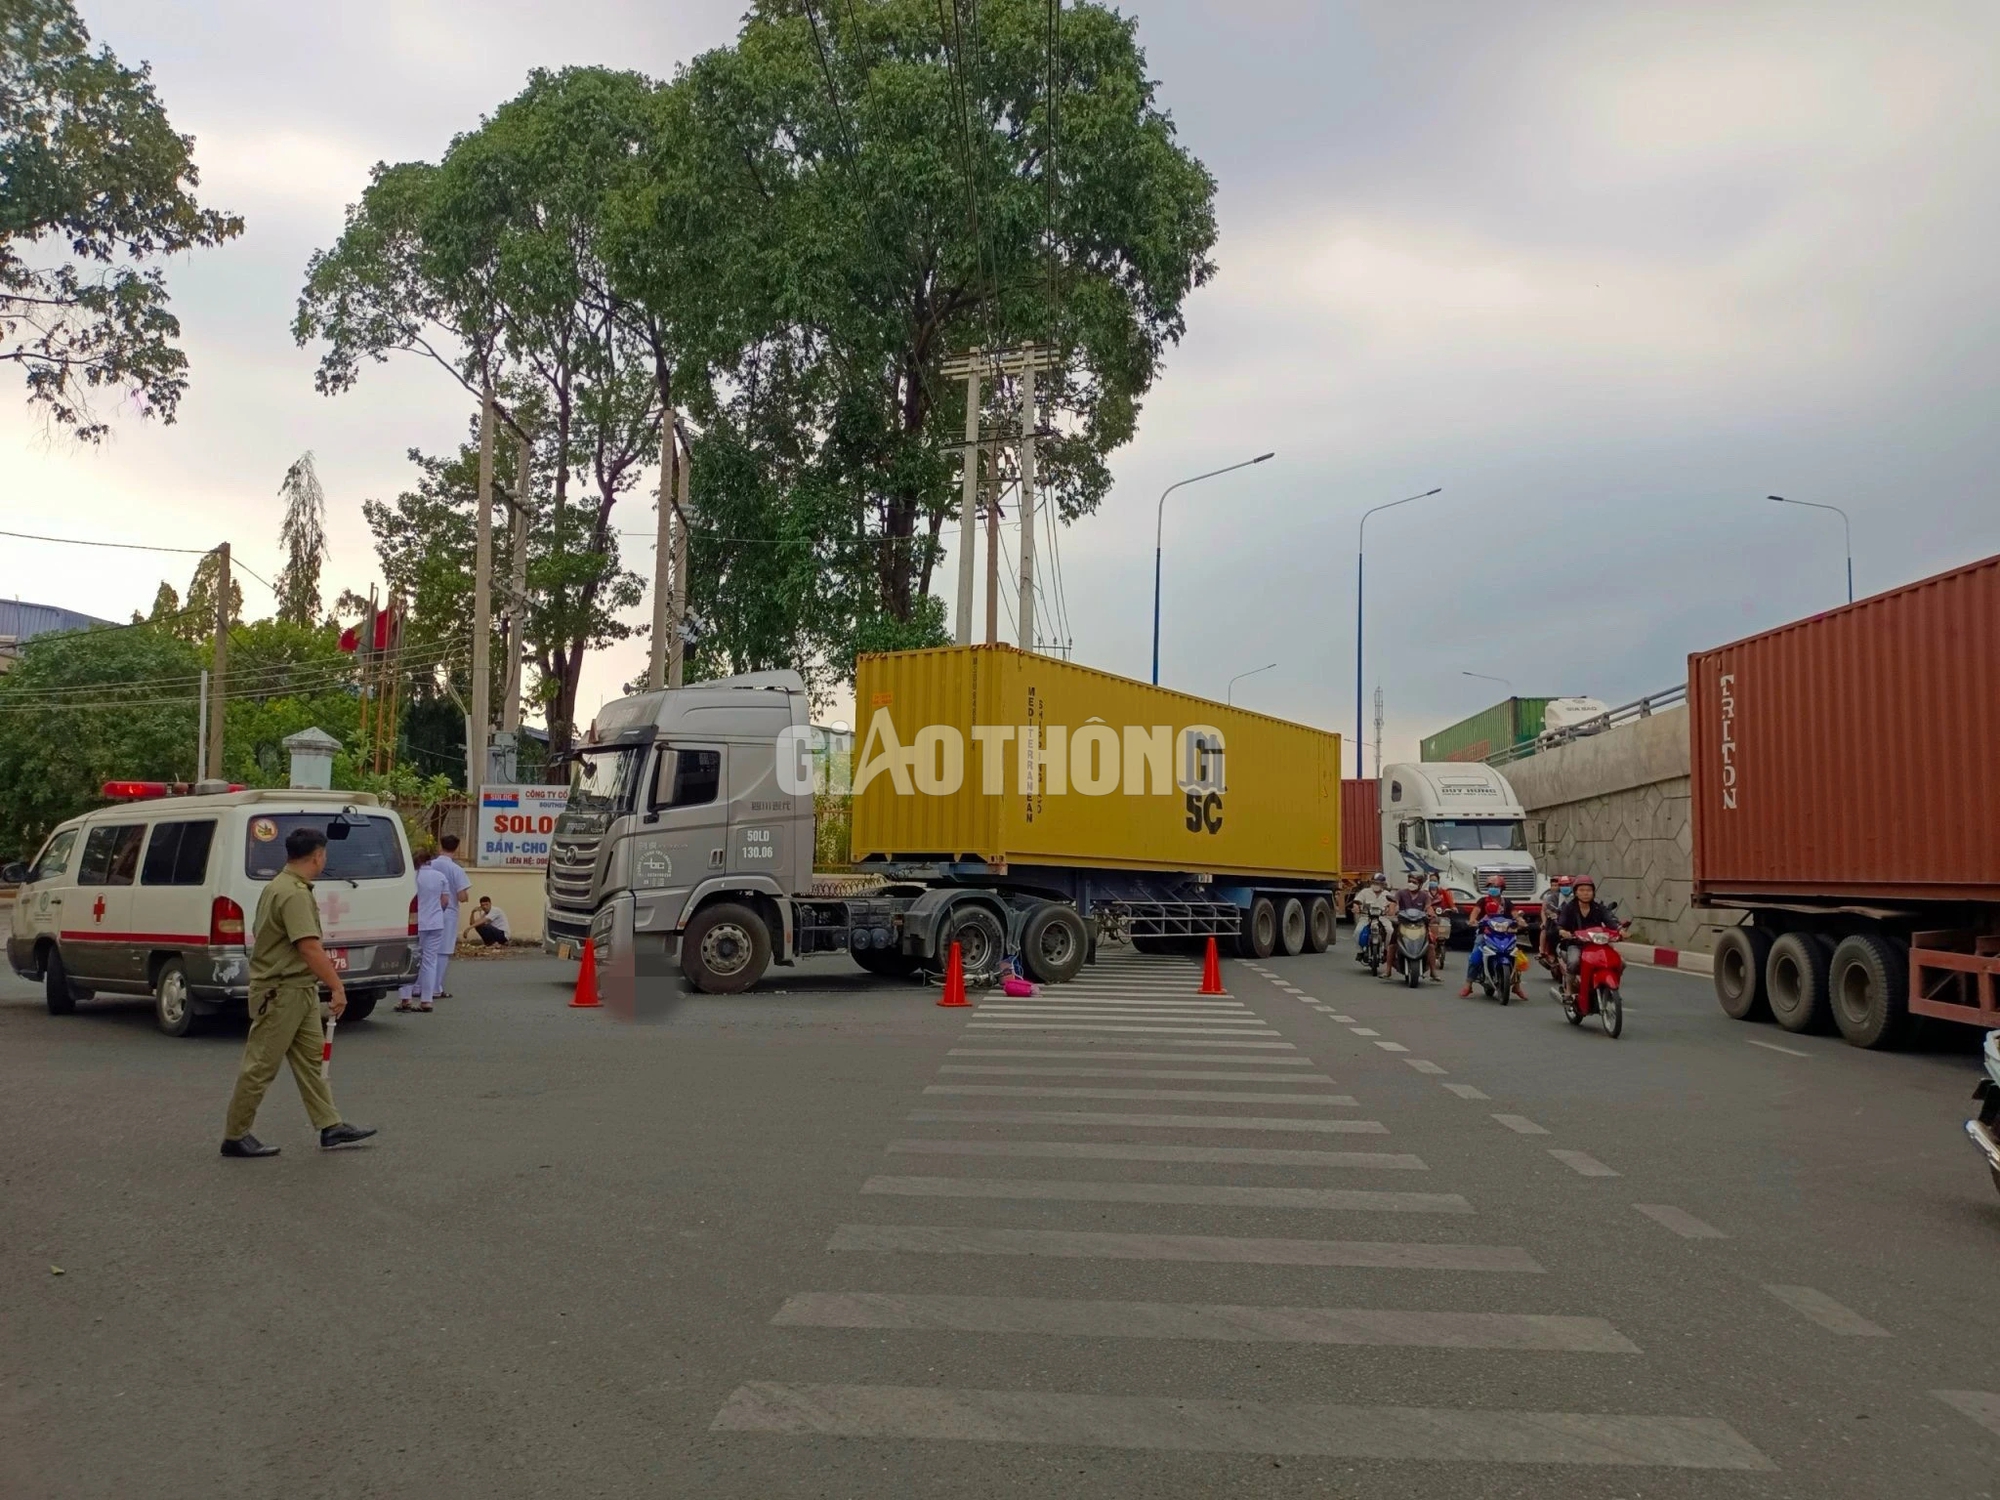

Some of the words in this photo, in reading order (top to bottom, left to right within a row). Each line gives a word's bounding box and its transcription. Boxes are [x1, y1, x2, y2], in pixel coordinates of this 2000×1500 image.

[1720, 674, 1737, 810] TRITON
[1026, 687, 1035, 823] MEDITERRANEAN
[525, 789, 545, 798] CÔNG
[494, 814, 558, 834] SOLO
[747, 830, 770, 842] 50LD
[742, 846, 773, 858] 130.06
[506, 856, 521, 864] LIÊN
